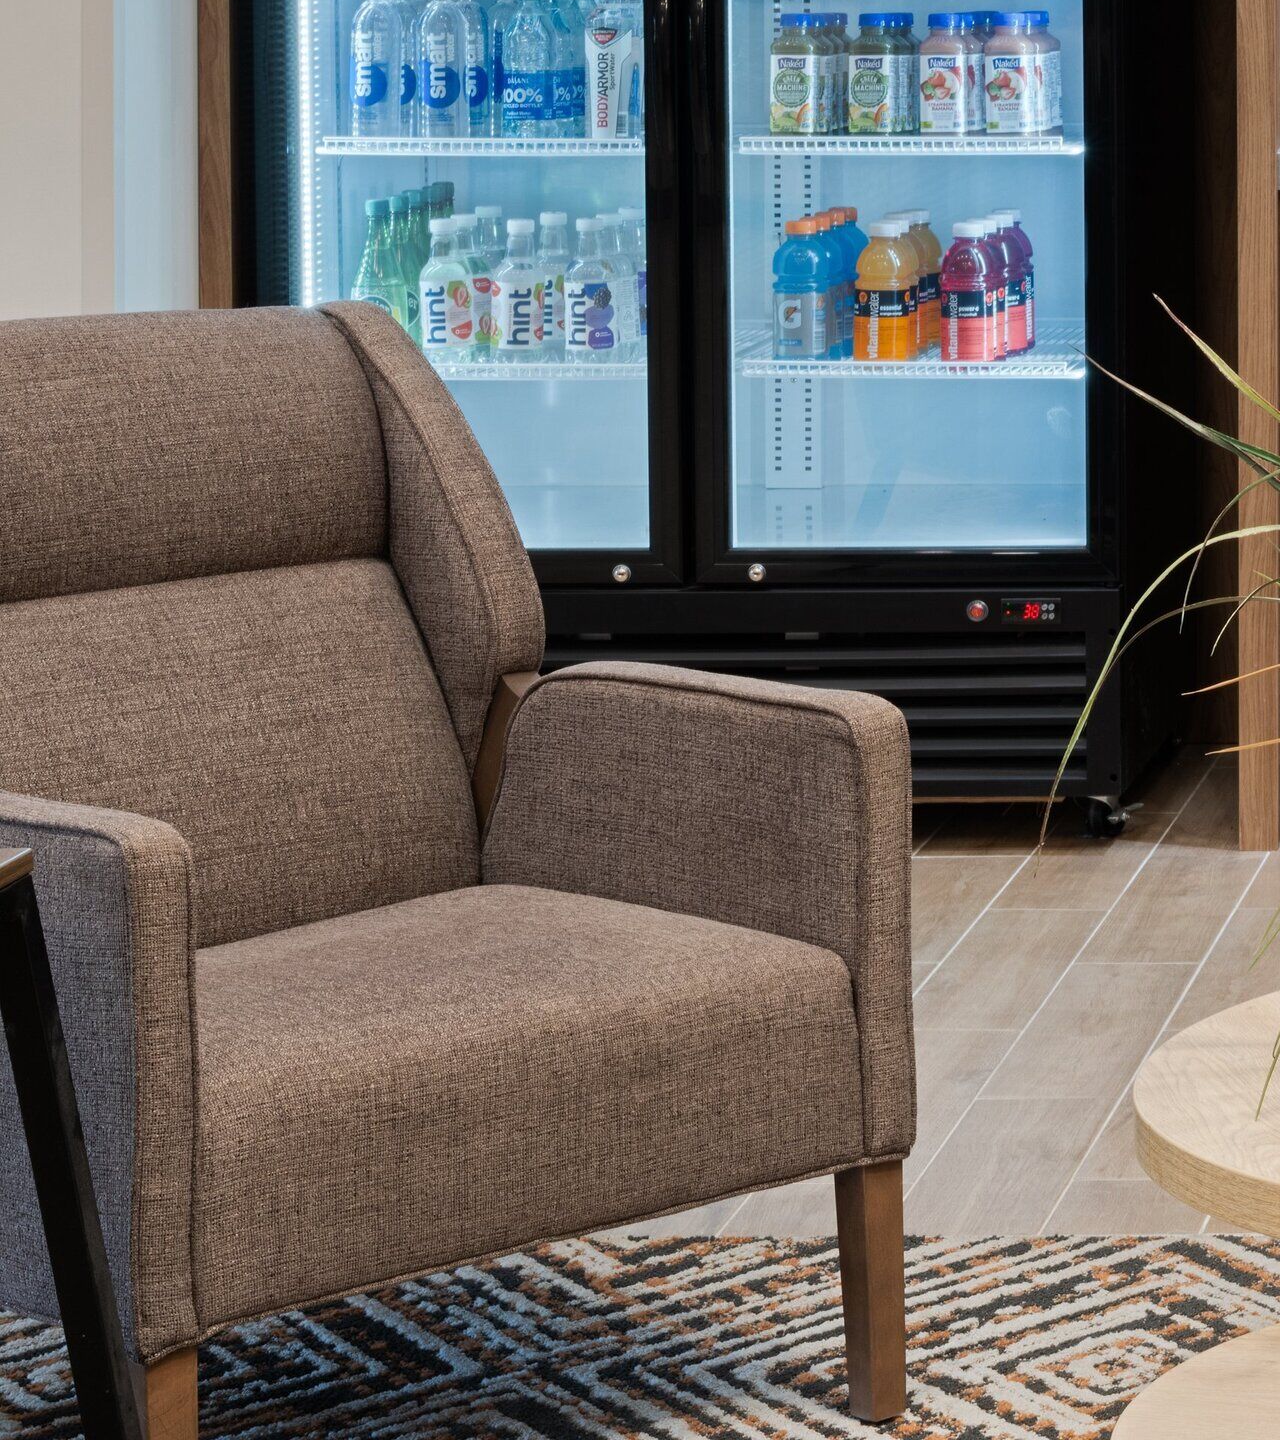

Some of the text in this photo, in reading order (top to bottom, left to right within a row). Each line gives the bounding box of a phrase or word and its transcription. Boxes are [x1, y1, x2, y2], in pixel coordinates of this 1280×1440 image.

[354, 31, 372, 99] smart
[429, 32, 446, 99] smart
[596, 51, 609, 129] BODYARMOR
[425, 285, 447, 345] hint
[507, 287, 532, 346] hint
[568, 287, 587, 347] hint
